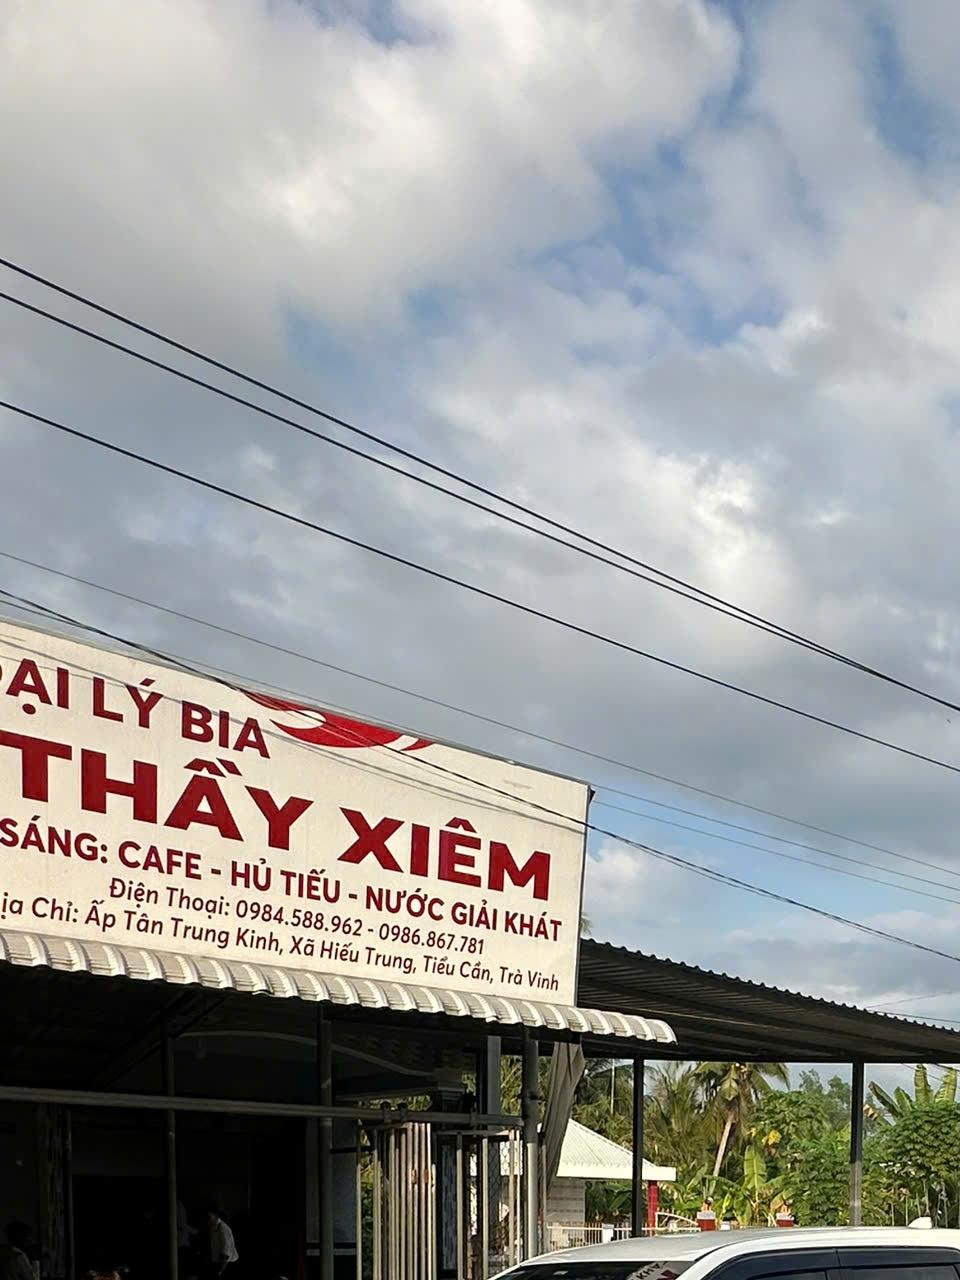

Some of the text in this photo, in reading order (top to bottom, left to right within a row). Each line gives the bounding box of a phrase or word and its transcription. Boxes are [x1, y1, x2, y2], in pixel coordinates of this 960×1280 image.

[0, 657, 271, 760] ẠI LÝ BIA
[0, 729, 551, 902] THẦY XIÊM
[0, 815, 562, 942] SÁNG: CAFE - HỦ TIẾU - NƯỚC GIẢI KHÁT
[109, 877, 159, 909] Điện
[165, 886, 230, 919] Thoại:
[236, 899, 363, 936] 0984.588.962
[379, 922, 484, 955] 0986.867.781
[1, 892, 559, 992] ịa Chỉ: Ấp Tân Trung Kinh, Xã Hiếu Trung, Tiểu Cần, Trà Vinh
